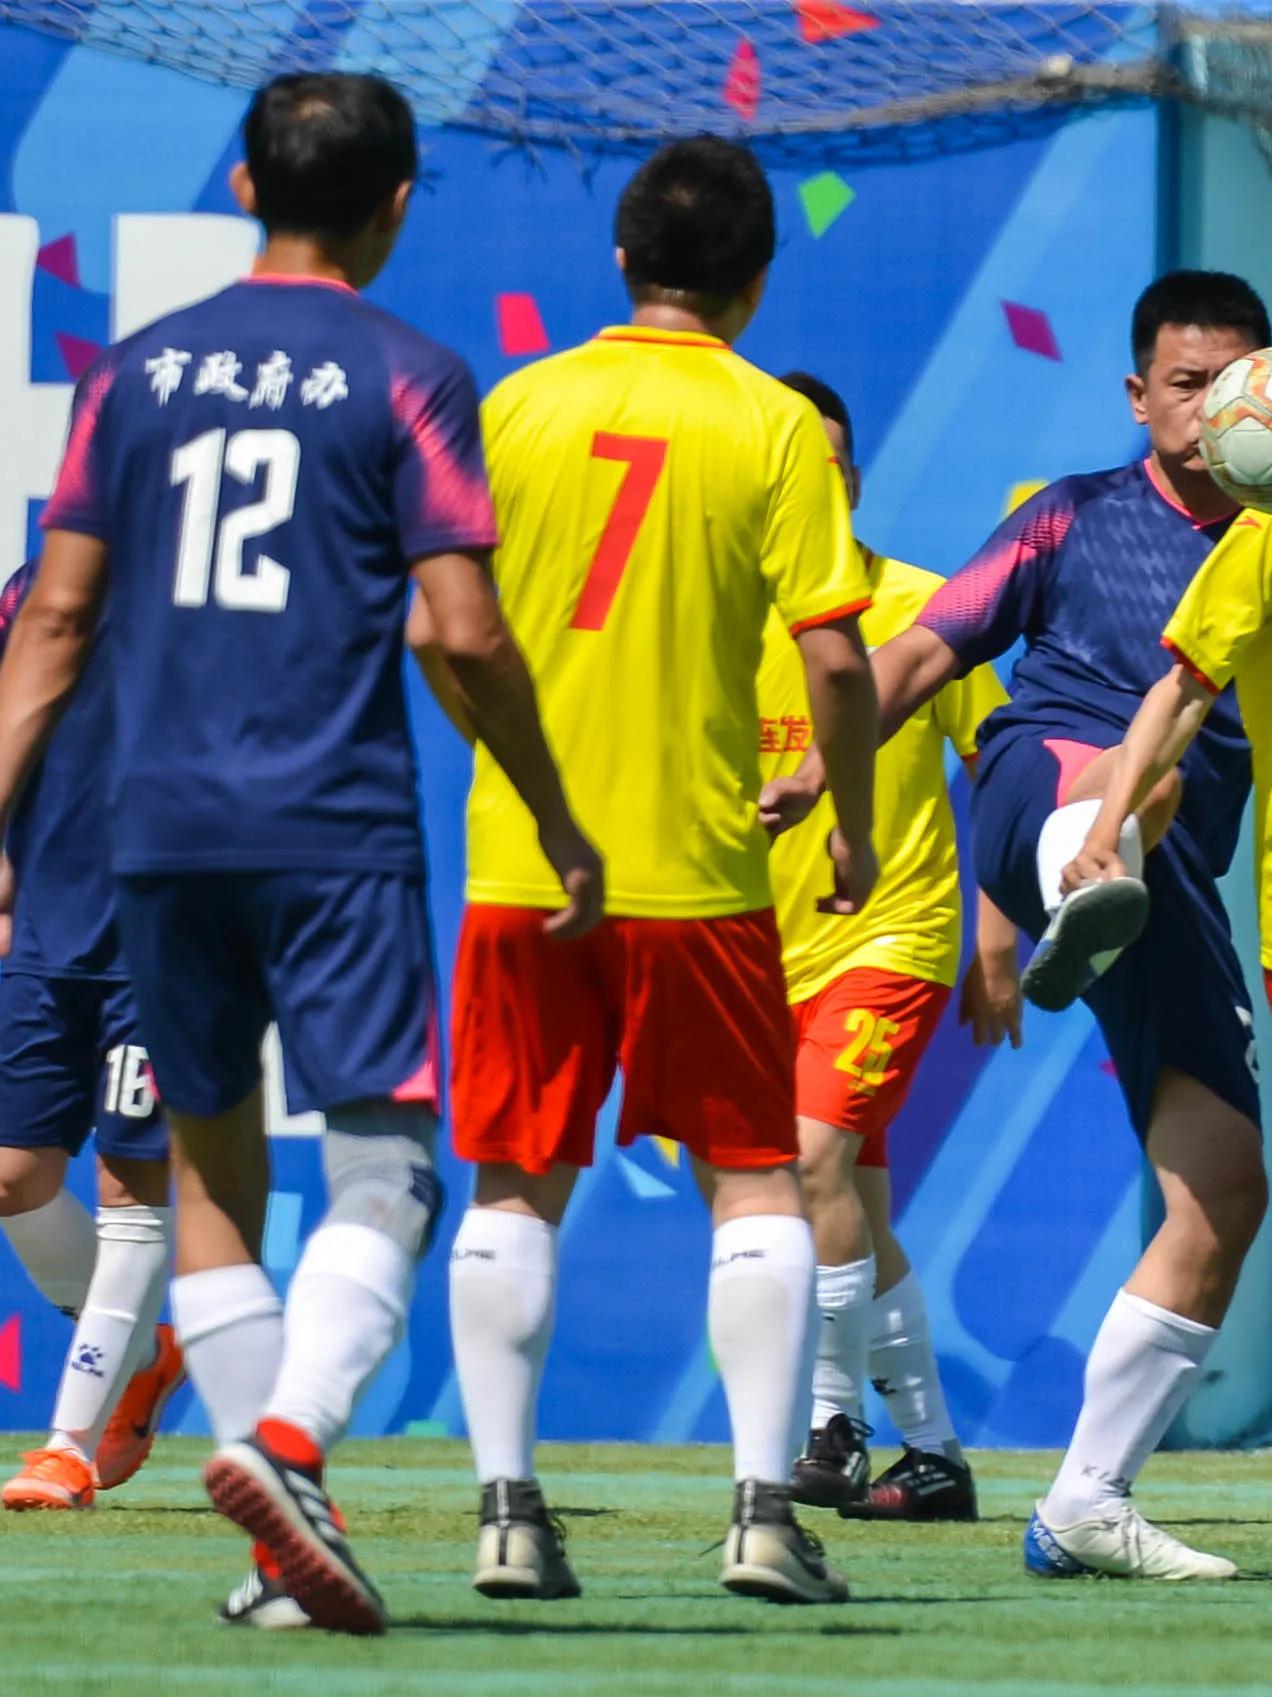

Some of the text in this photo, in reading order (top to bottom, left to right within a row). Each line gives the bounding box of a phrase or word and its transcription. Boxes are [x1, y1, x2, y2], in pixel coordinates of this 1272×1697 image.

[145, 347, 349, 411] 市政府办
[170, 427, 301, 613] 12
[570, 430, 669, 631] 7
[834, 1008, 900, 1085] 25
